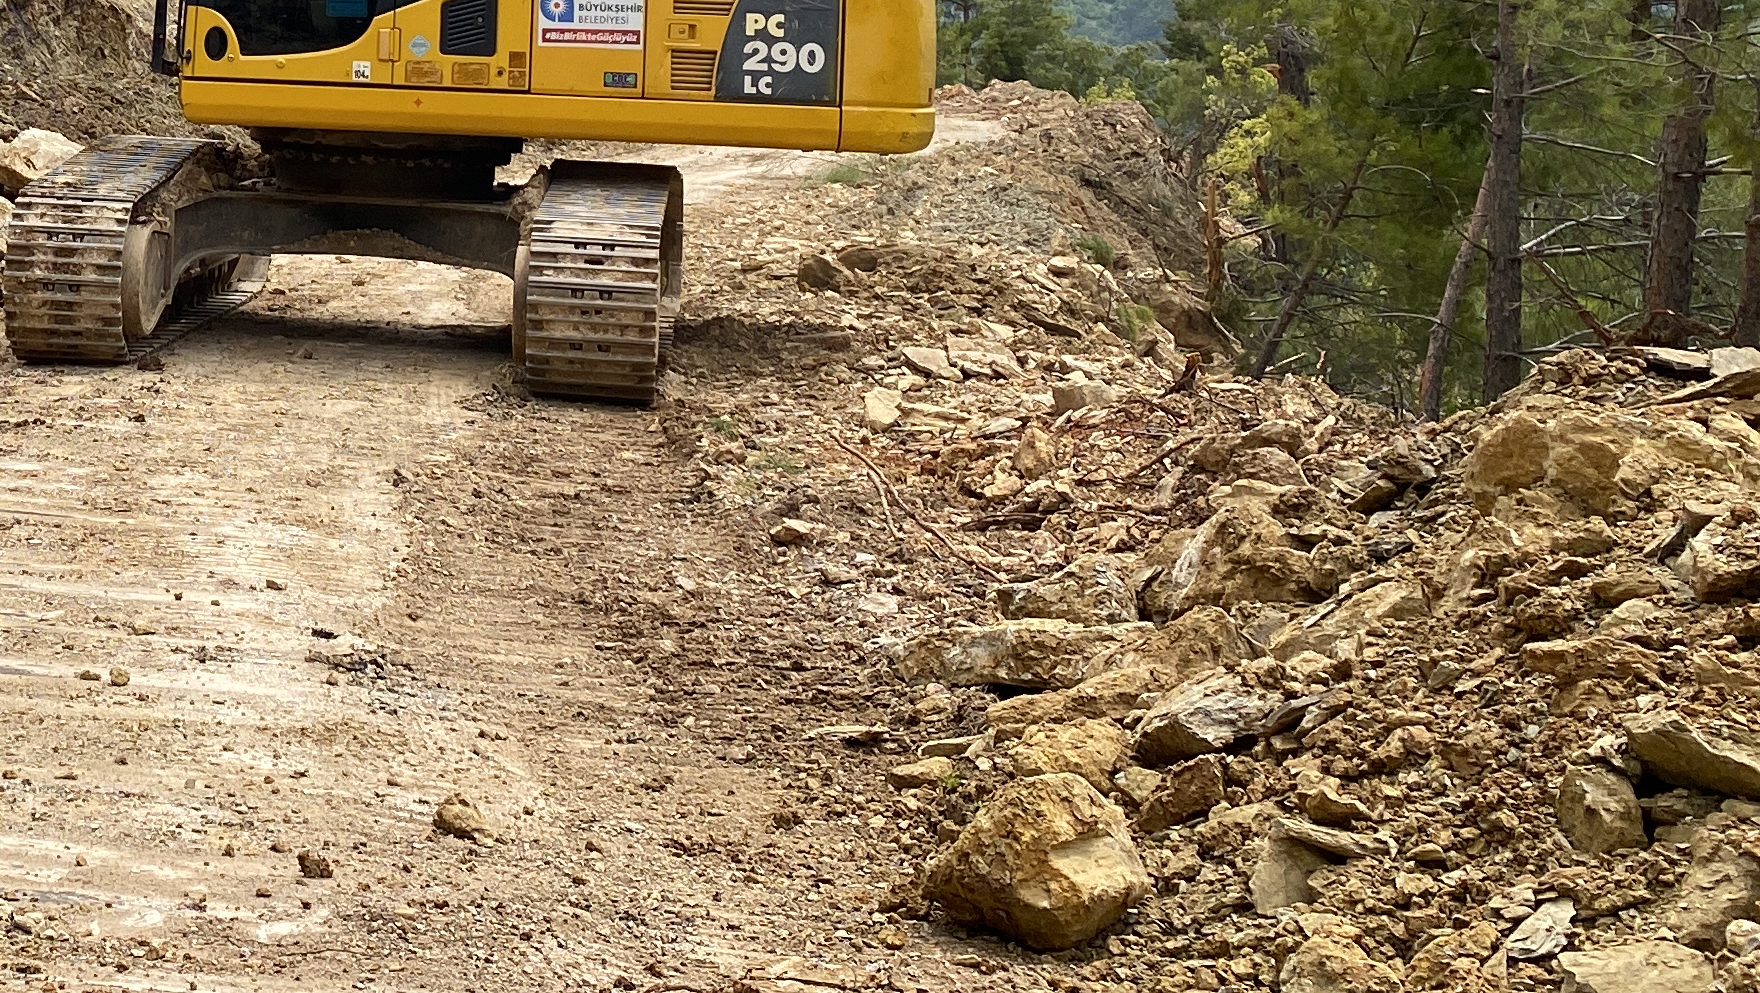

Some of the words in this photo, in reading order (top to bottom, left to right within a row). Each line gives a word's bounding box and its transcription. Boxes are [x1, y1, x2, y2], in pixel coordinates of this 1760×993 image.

[578, 1, 643, 14] BÜYÜKŞEHİR
[578, 15, 629, 25] BELEDİYESİ
[745, 12, 785, 38] PC
[742, 40, 826, 74] 290
[743, 75, 773, 95] LC
